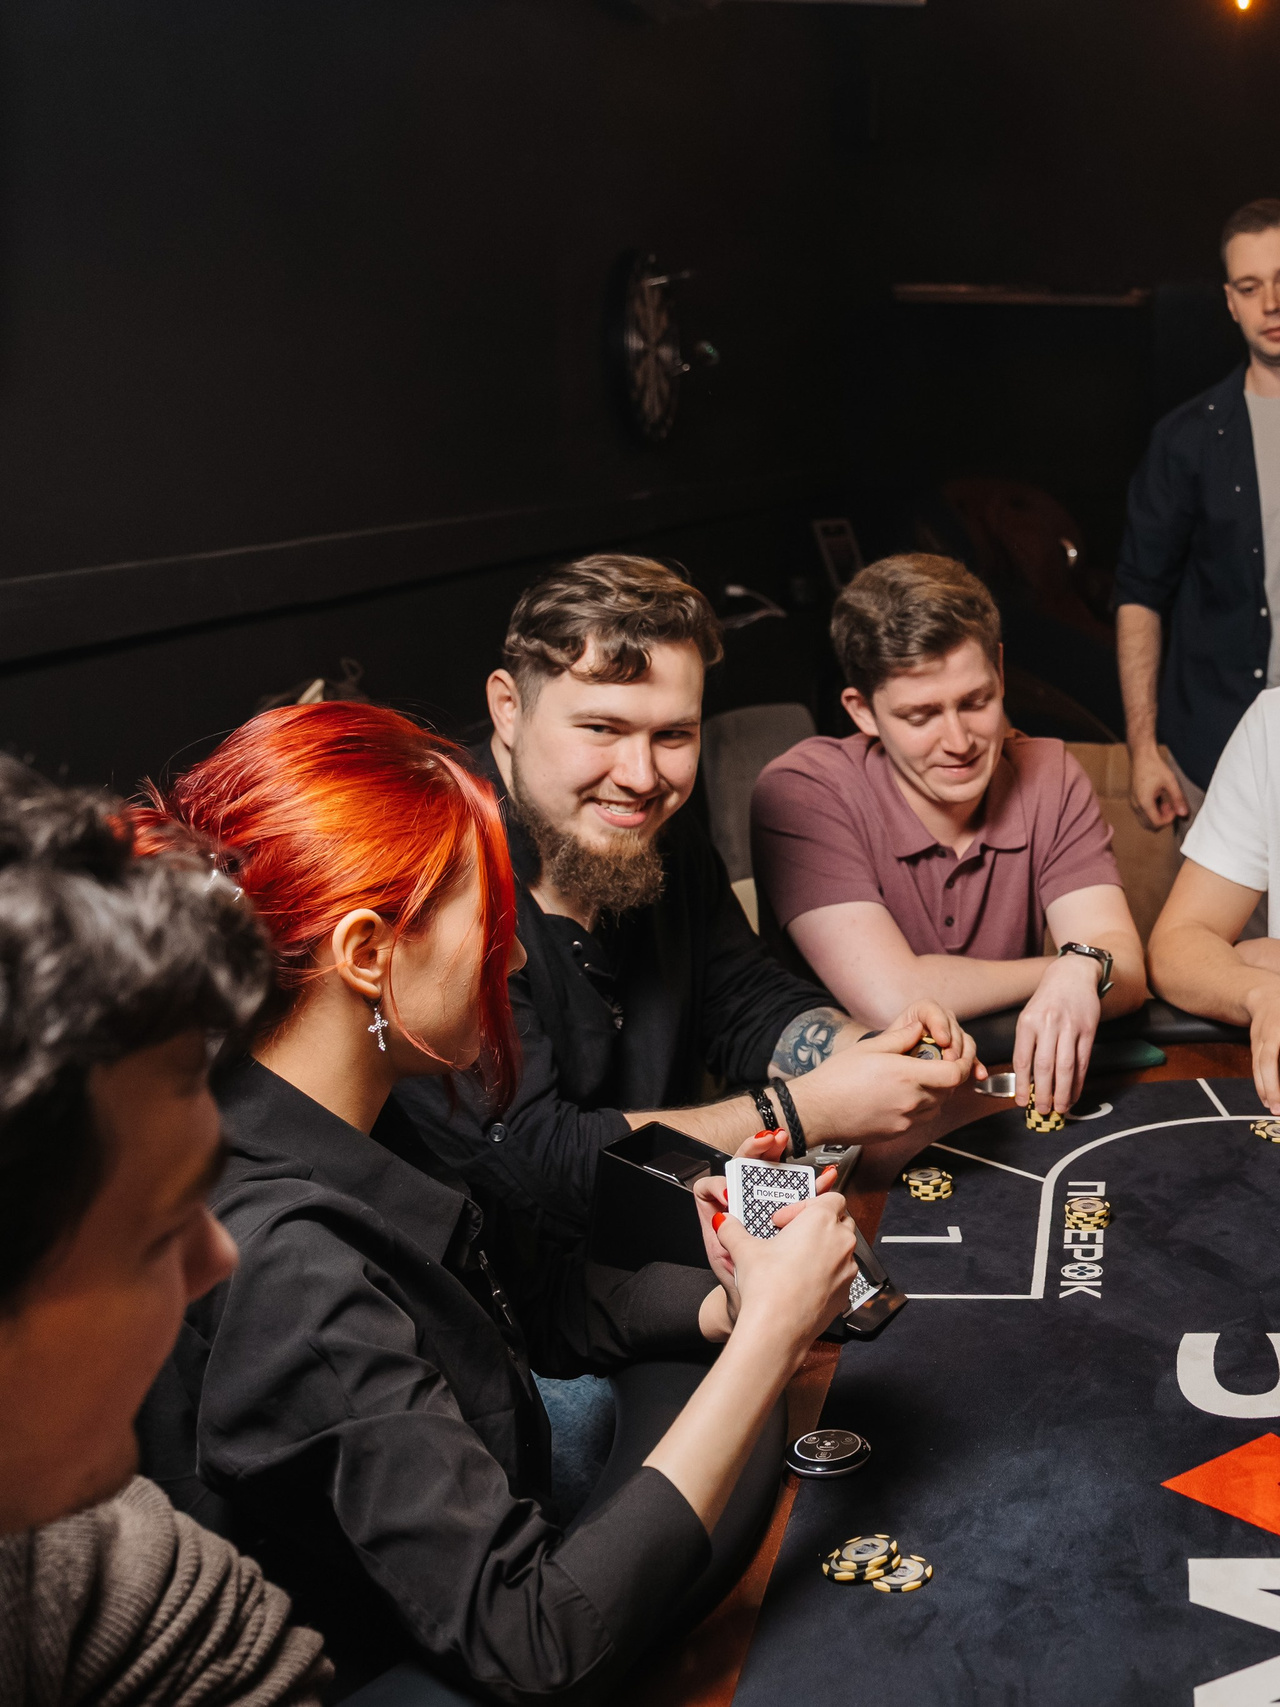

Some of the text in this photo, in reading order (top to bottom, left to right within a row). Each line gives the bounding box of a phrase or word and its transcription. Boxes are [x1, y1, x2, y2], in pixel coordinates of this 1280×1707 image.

[756, 1188, 797, 1201] ПОКЕРОК
[881, 1225, 963, 1243] 1
[1059, 1181, 1106, 1299] ПЕРОК
